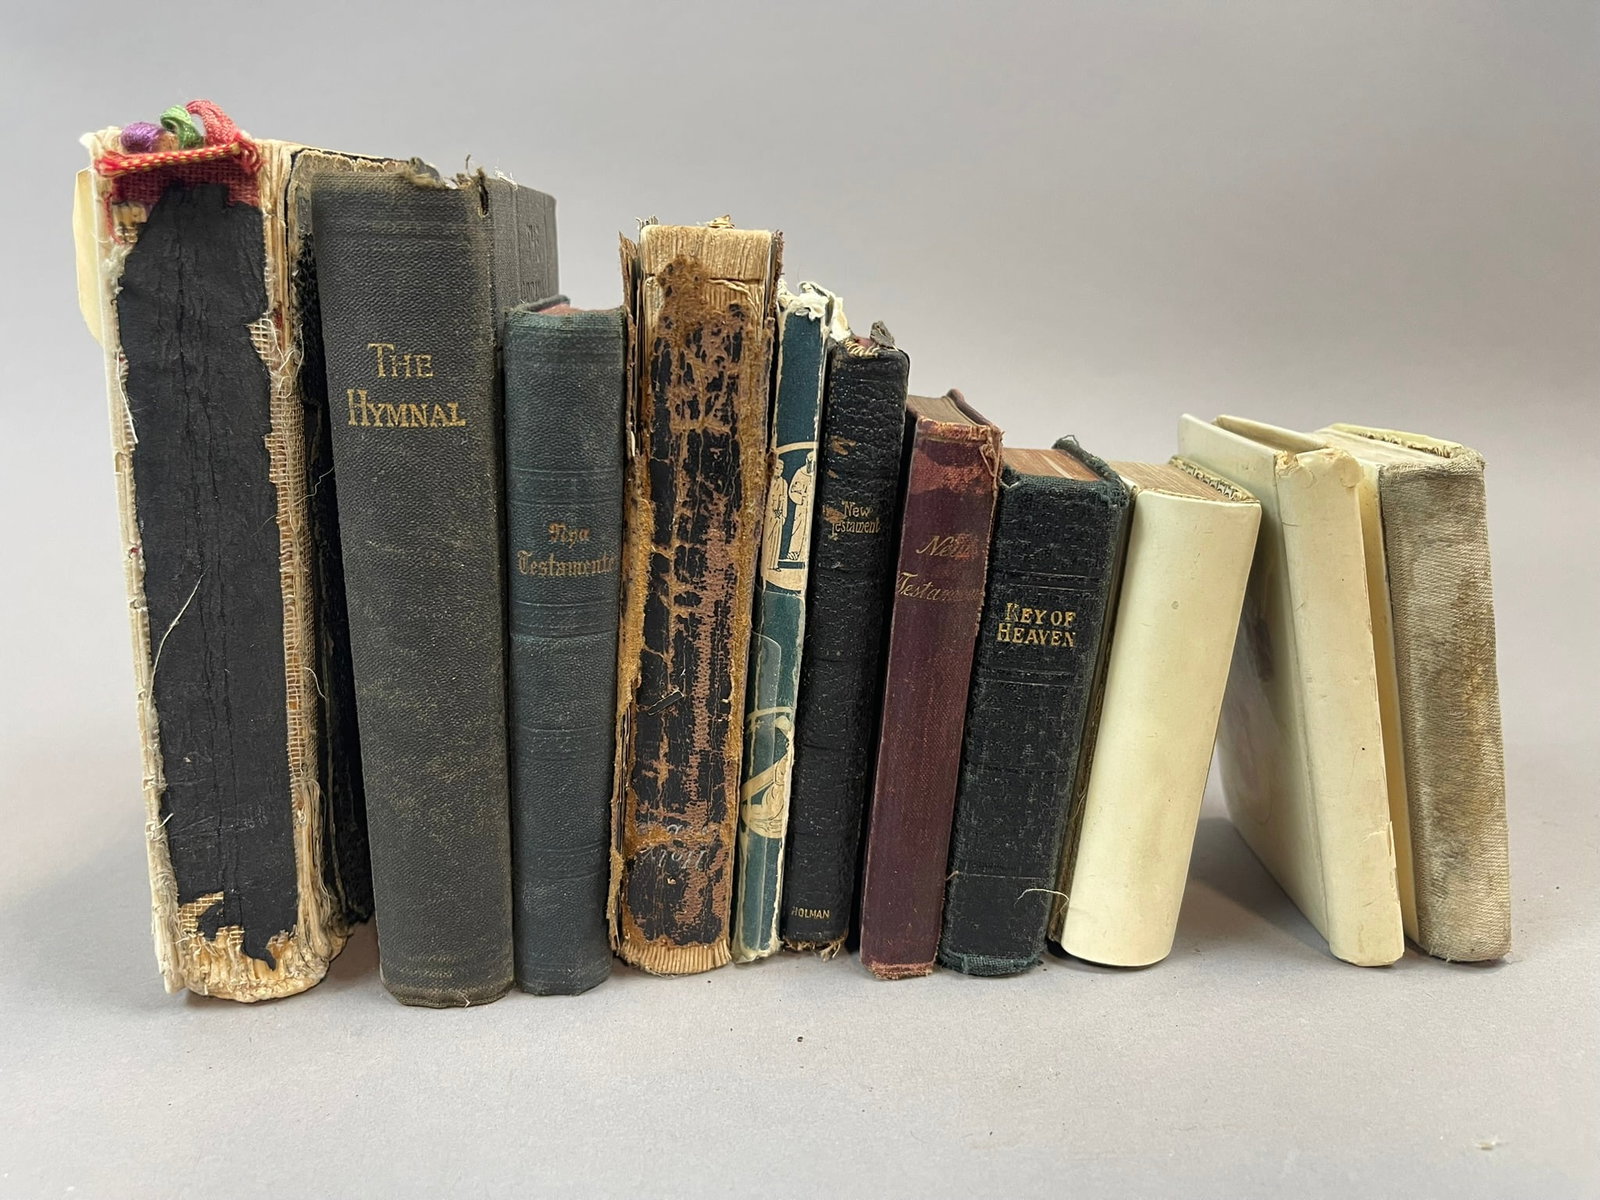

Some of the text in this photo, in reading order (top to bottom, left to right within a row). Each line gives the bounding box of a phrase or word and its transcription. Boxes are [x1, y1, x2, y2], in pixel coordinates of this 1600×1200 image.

[841, 500, 874, 518] New
[1005, 602, 1077, 628] KEY OF
[997, 622, 1076, 648] HEAVEN
[791, 905, 830, 919] HOLMAN
